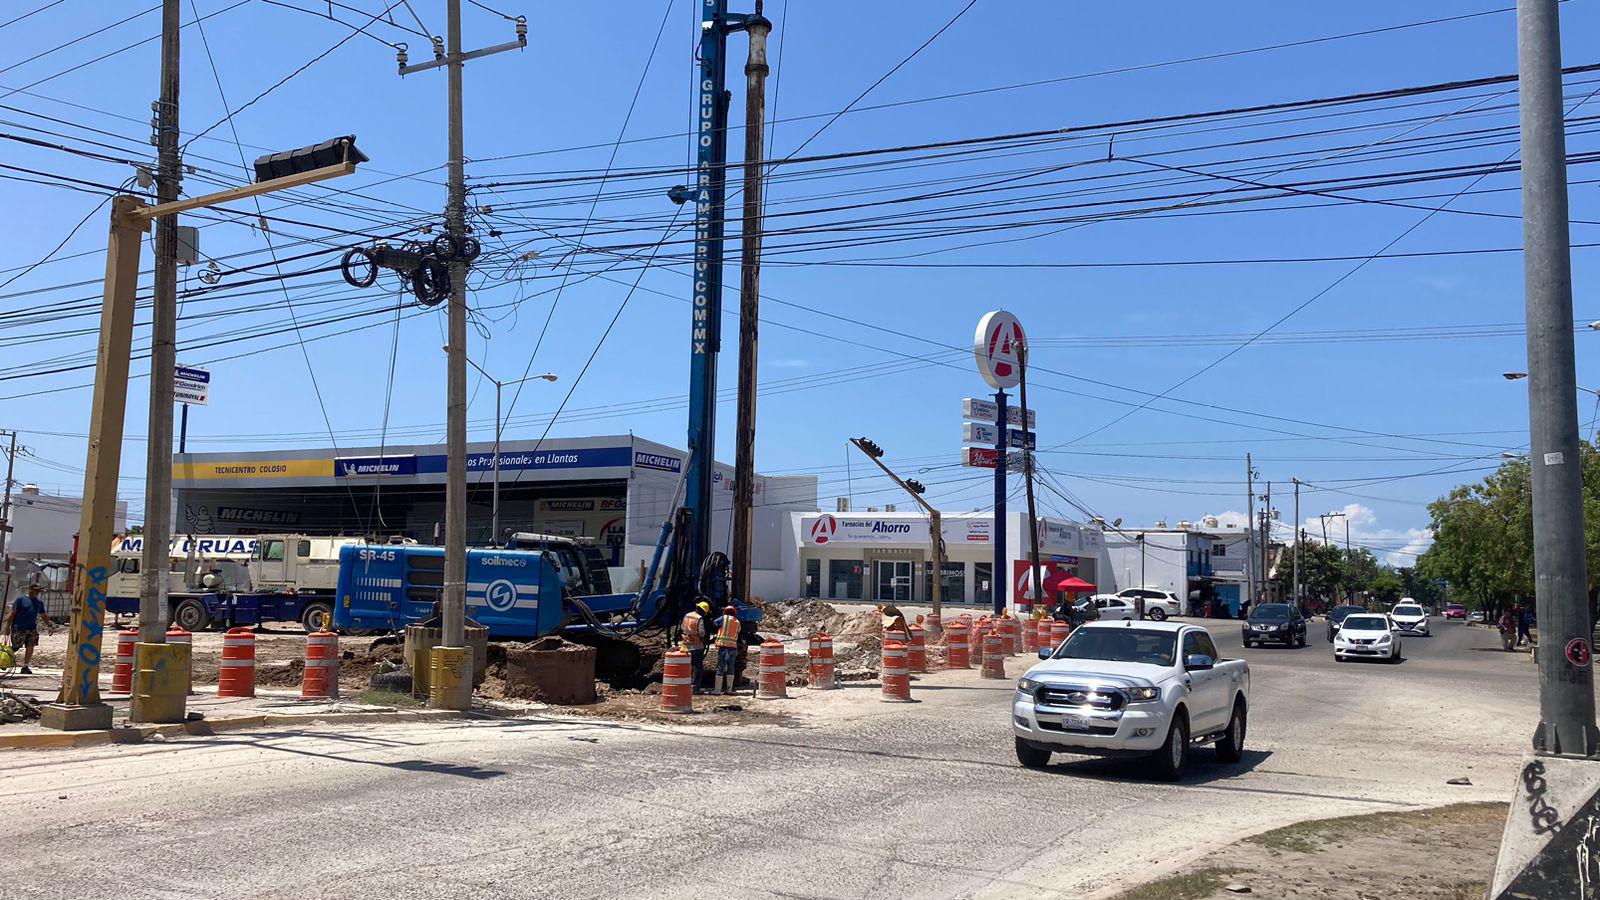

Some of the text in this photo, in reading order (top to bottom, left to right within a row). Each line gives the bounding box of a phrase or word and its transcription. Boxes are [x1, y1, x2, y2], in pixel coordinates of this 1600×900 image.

[700, 80, 713, 147] GRUPO
[465, 453, 579, 469] os Profsionales en Llantas
[636, 453, 680, 469] MICHELIN
[215, 464, 287, 475] TECNICENTRO COLOSIO
[357, 464, 400, 473] MICHELIN
[551, 501, 592, 509] MICHELIN
[221, 508, 299, 523] MICHELIN
[842, 520, 864, 528] Farmacias
[872, 521, 910, 533] Ahorro
[359, 550, 396, 561] SR-45
[481, 555, 520, 567] soilmec
